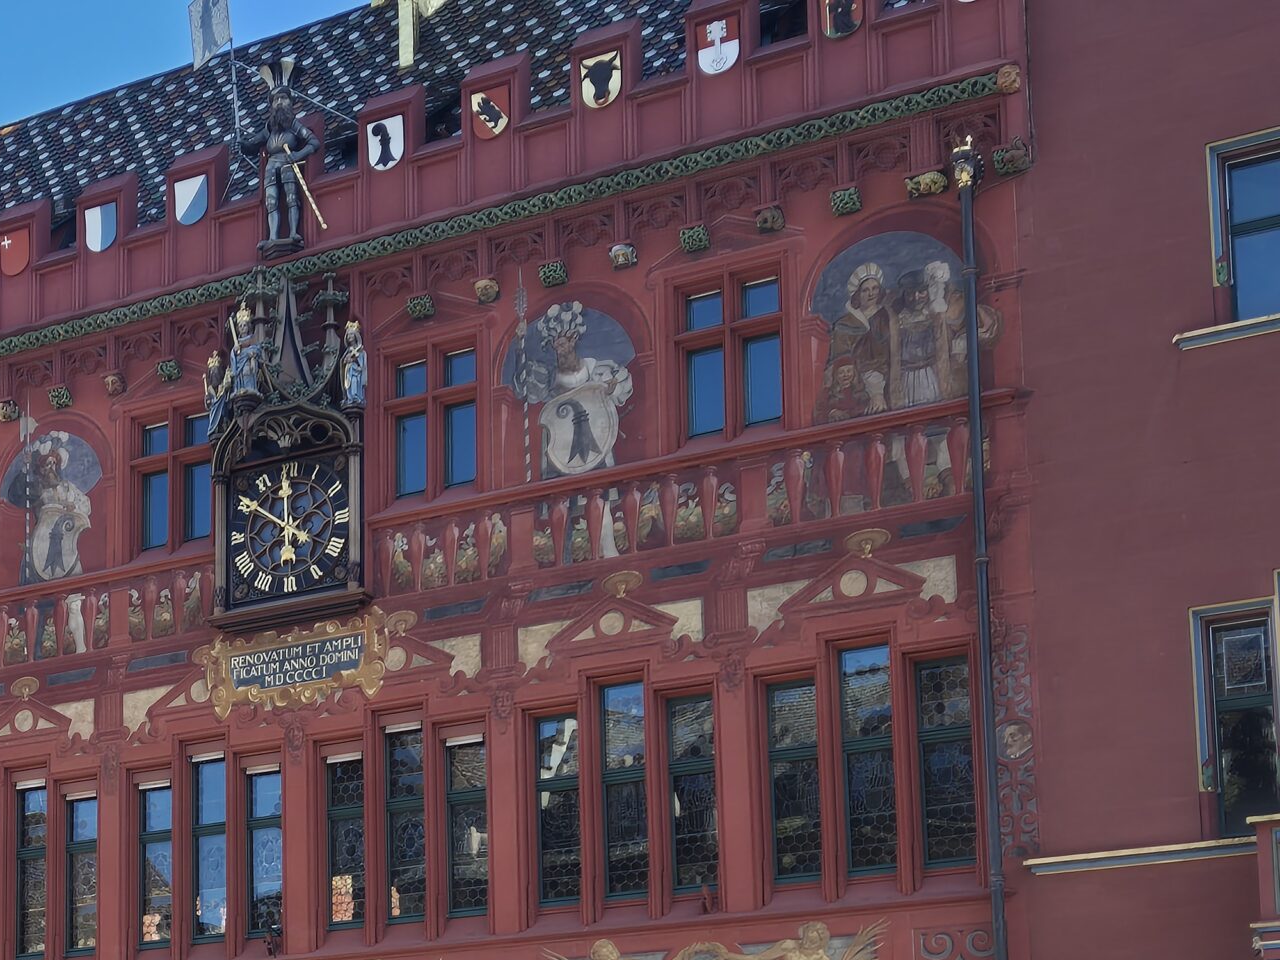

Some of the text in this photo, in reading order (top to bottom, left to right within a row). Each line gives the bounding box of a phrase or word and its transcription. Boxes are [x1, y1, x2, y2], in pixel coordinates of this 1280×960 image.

[231, 635, 361, 668] RENOVATUM ET AMPLI
[233, 649, 359, 680] FICATUM ANNO DOMINI
